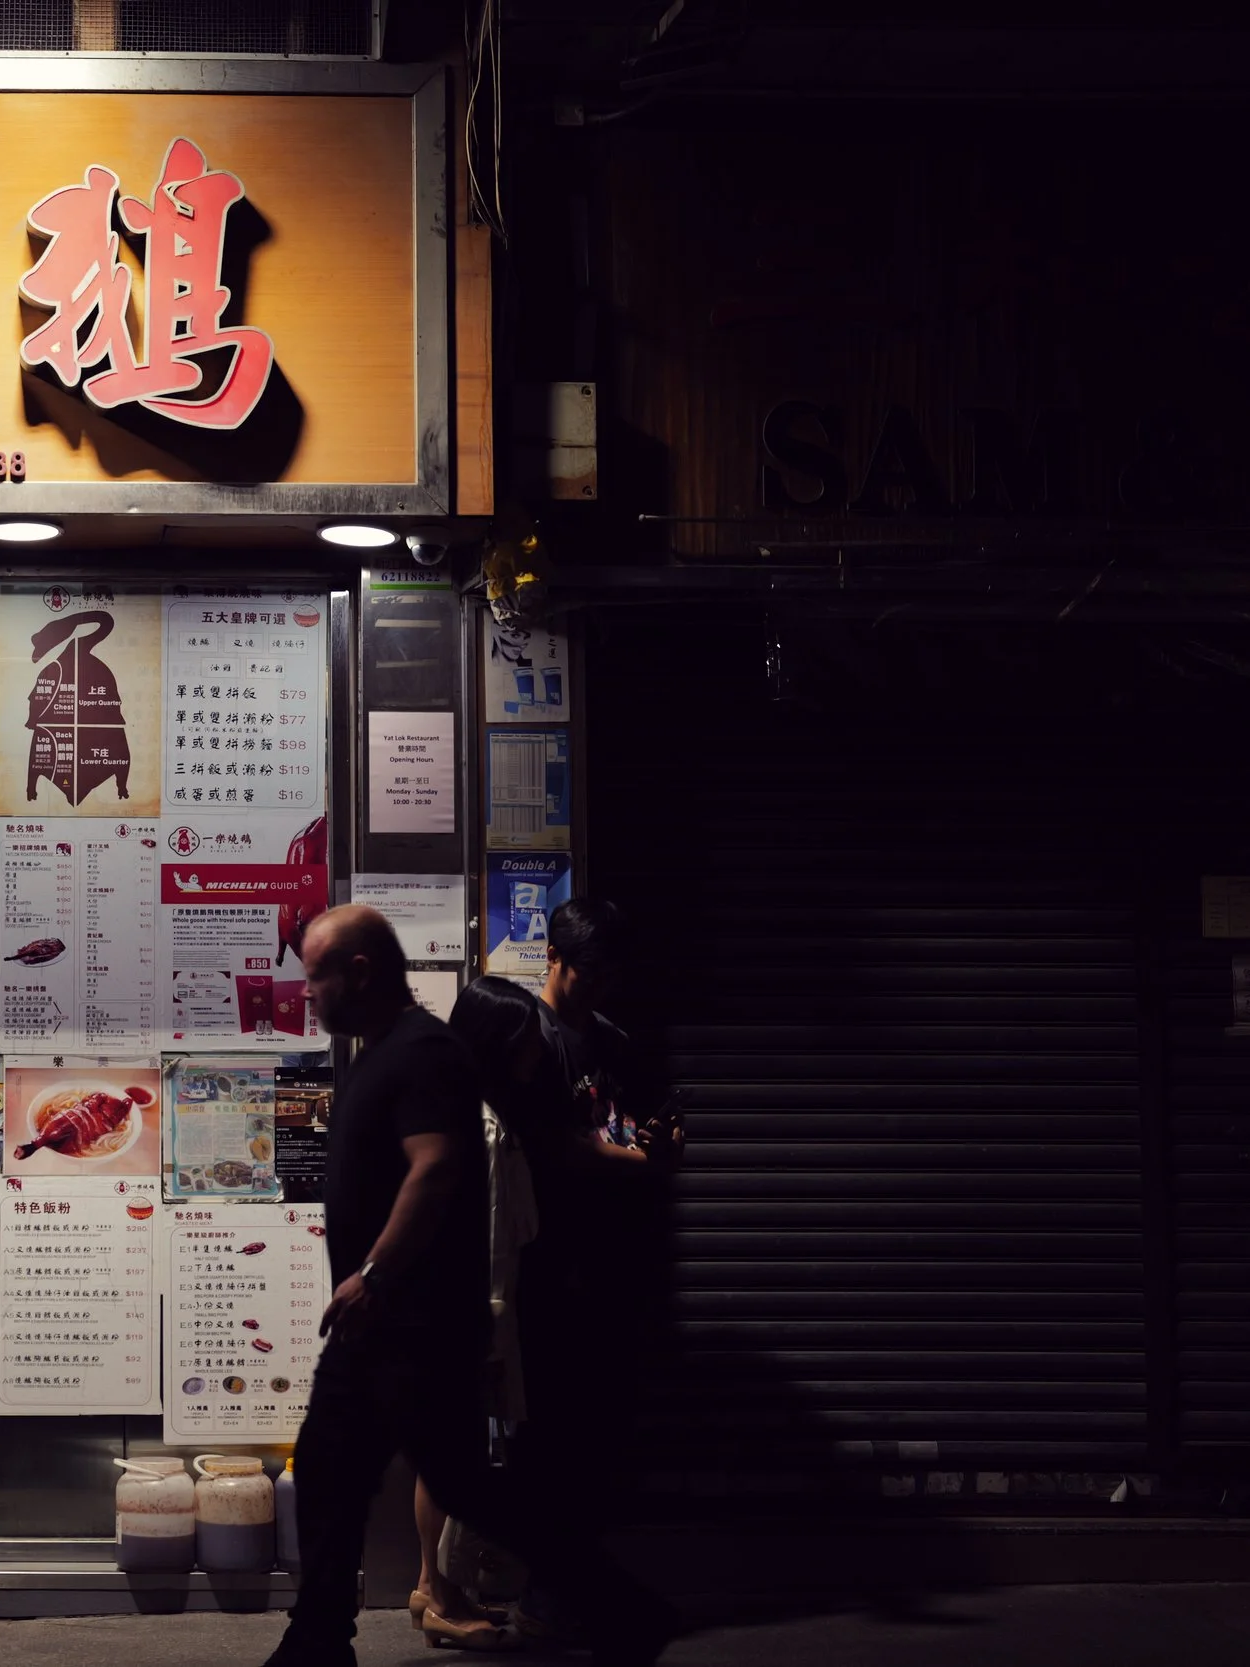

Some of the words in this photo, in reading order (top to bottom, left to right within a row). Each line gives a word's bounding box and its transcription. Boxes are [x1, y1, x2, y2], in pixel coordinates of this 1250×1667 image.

[201, 611, 286, 625] 五大皇牌可選
[279, 689, 307, 700] $79
[279, 714, 306, 725] $77
[278, 739, 307, 750] $98
[389, 756, 415, 764] Opening
[278, 765, 310, 775] $119
[278, 790, 303, 801] $16
[502, 860, 545, 870] Double
[546, 860, 556, 870] A
[205, 882, 269, 890] MICHELIN
[270, 882, 298, 890] GUIDE
[14, 1201, 71, 1215] 特色飯粉
[290, 1263, 313, 1271] $255
